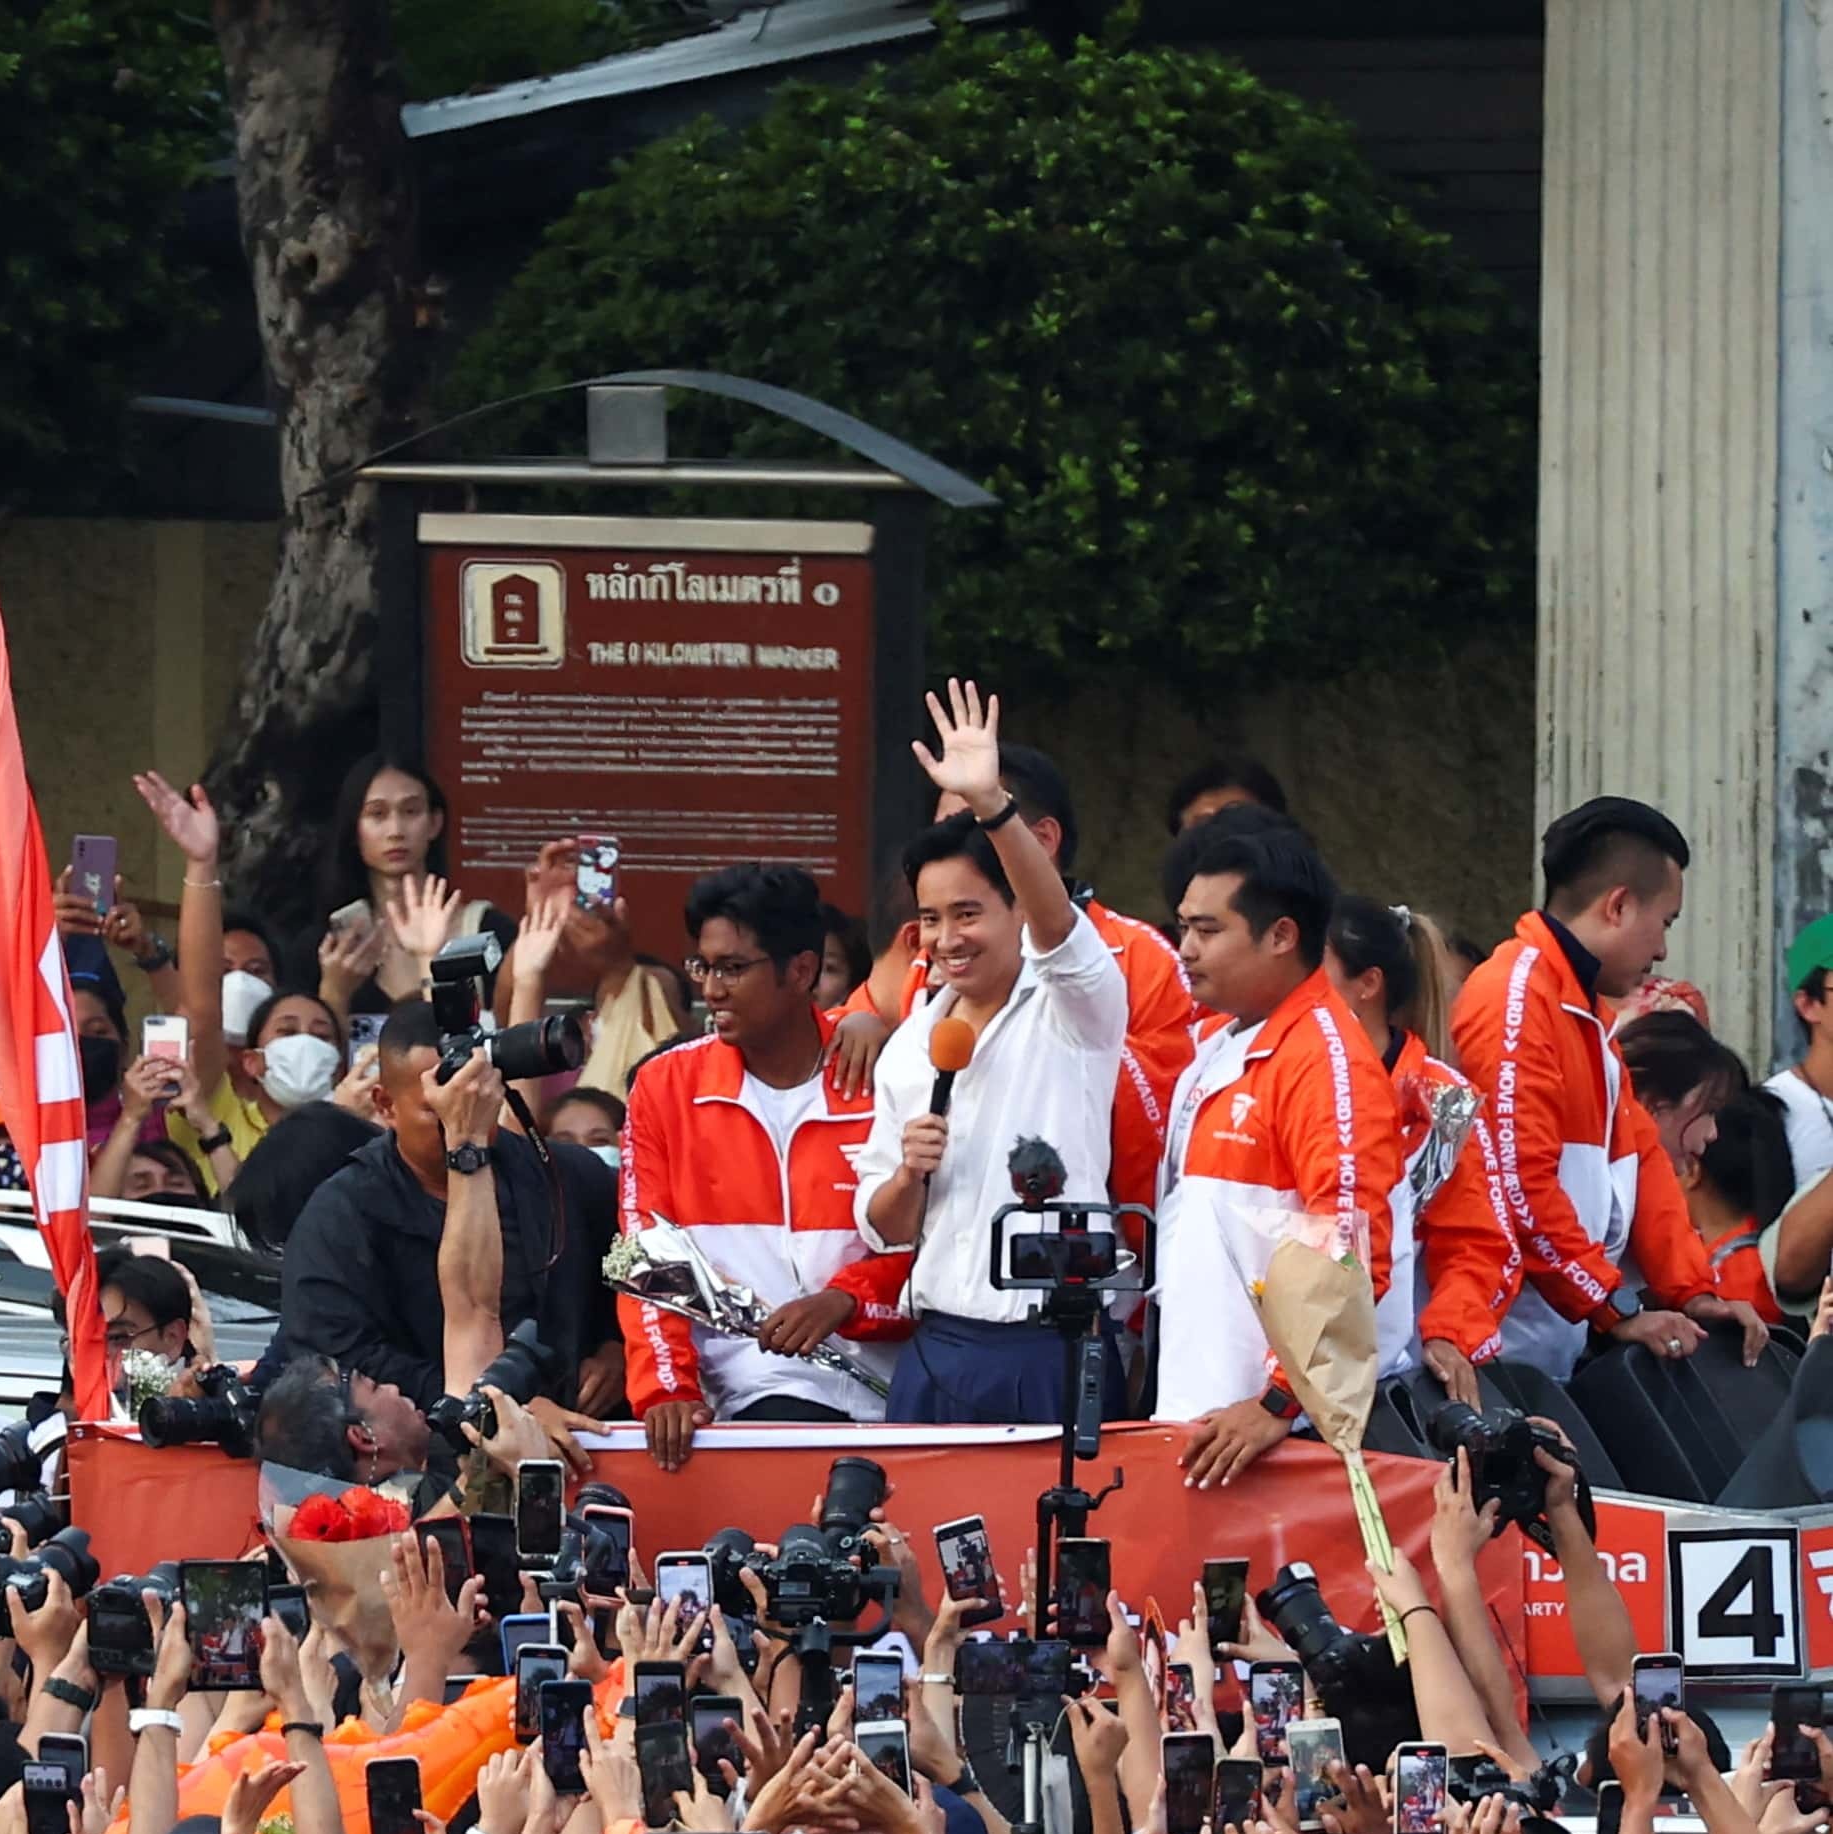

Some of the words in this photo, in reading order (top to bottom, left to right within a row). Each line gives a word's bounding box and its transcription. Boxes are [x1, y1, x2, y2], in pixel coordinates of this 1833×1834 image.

[587, 643, 624, 665] THE
[628, 643, 638, 665] 0
[643, 643, 751, 666] KILOMETER
[755, 644, 840, 670] MARKER
[1119, 1045, 1162, 1123] ORWARD
[1324, 1036, 1354, 1129] FORWARD
[1497, 1060, 1517, 1114] MOVE
[1473, 1117, 1499, 1172] MOVE
[1497, 1118, 1527, 1213] FORWARD
[1337, 1152, 1356, 1215] MOVE
[1523, 1601, 1566, 1617] ARTY
[1697, 1546, 1785, 1658] 4
